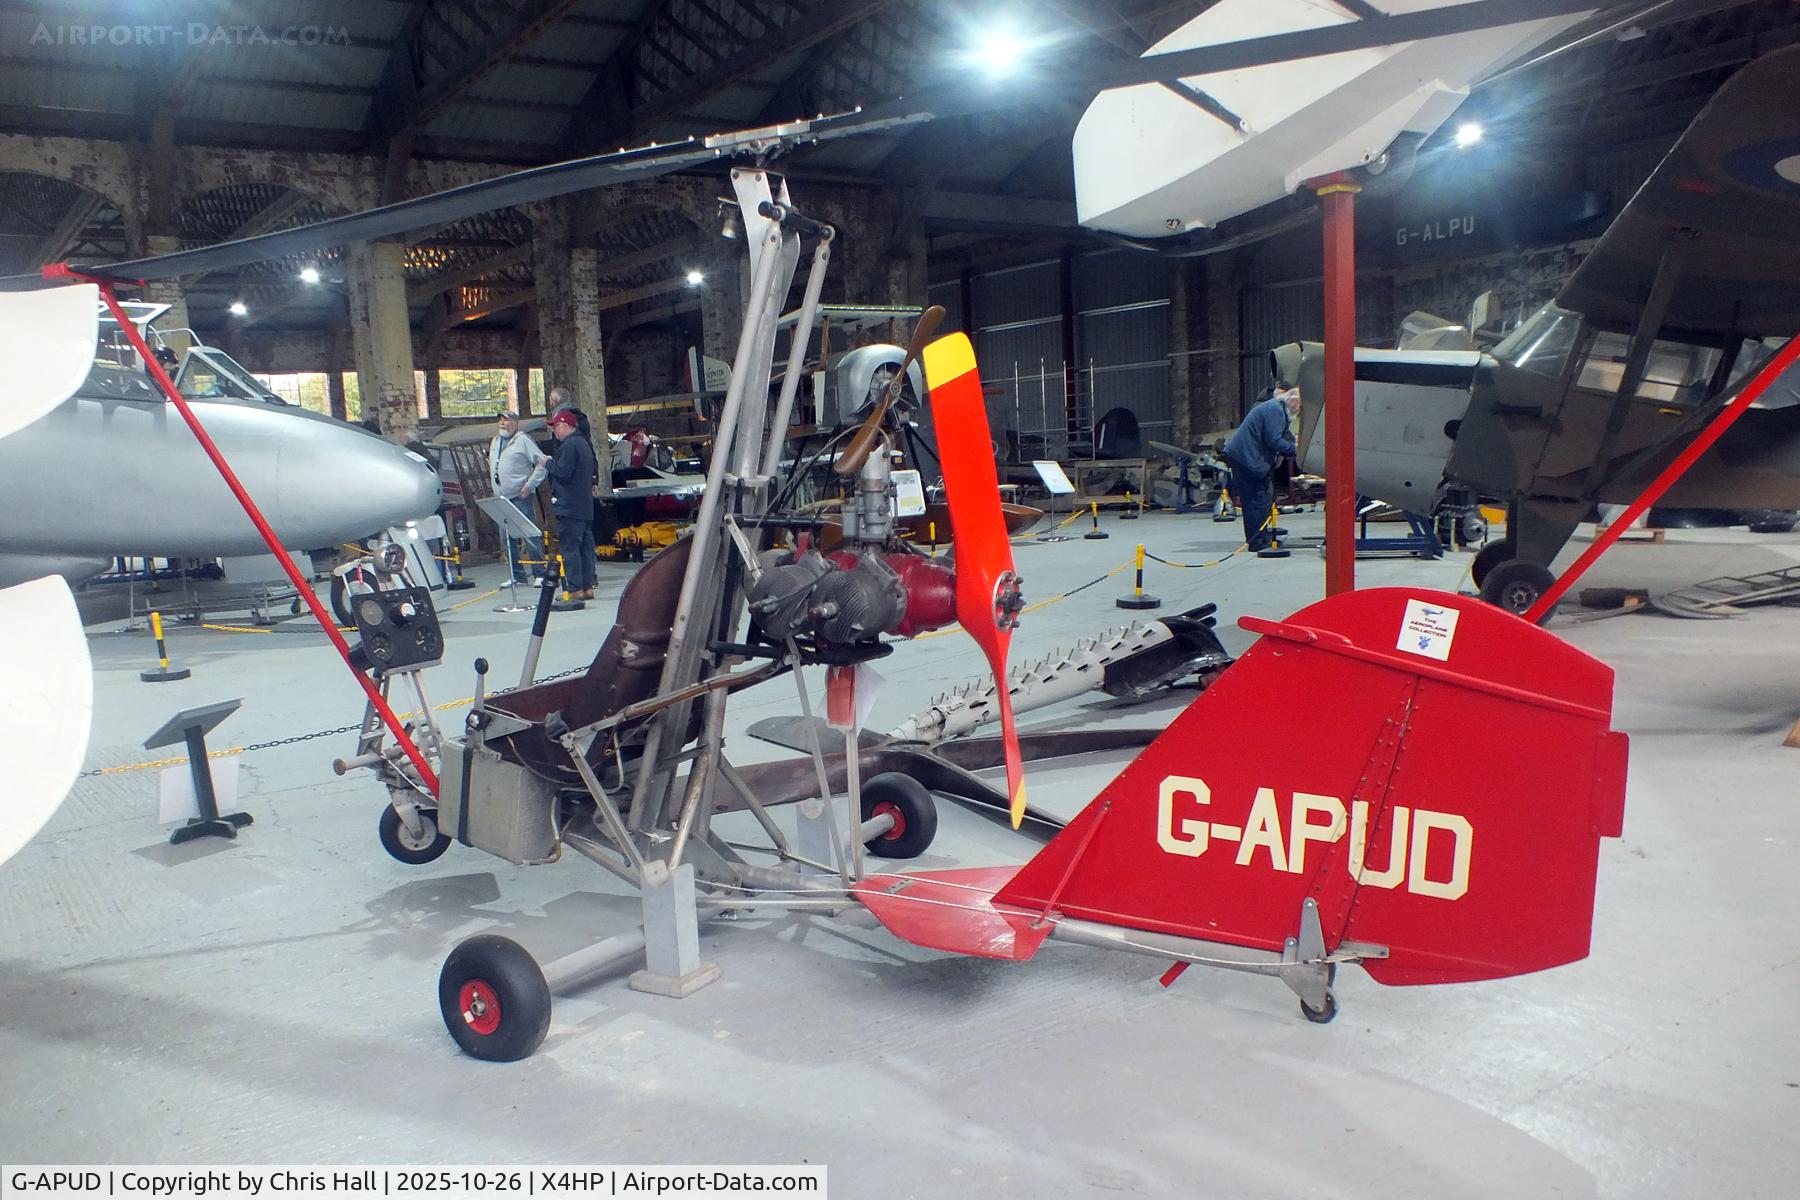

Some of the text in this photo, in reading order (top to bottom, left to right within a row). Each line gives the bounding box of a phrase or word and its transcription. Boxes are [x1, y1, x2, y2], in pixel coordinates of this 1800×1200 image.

[1397, 216, 1474, 246] G-ALPU
[1408, 625, 1448, 638] COLLECTION
[1409, 620, 1448, 632] AEROPLANE
[1157, 775, 1473, 901] G-APUD
